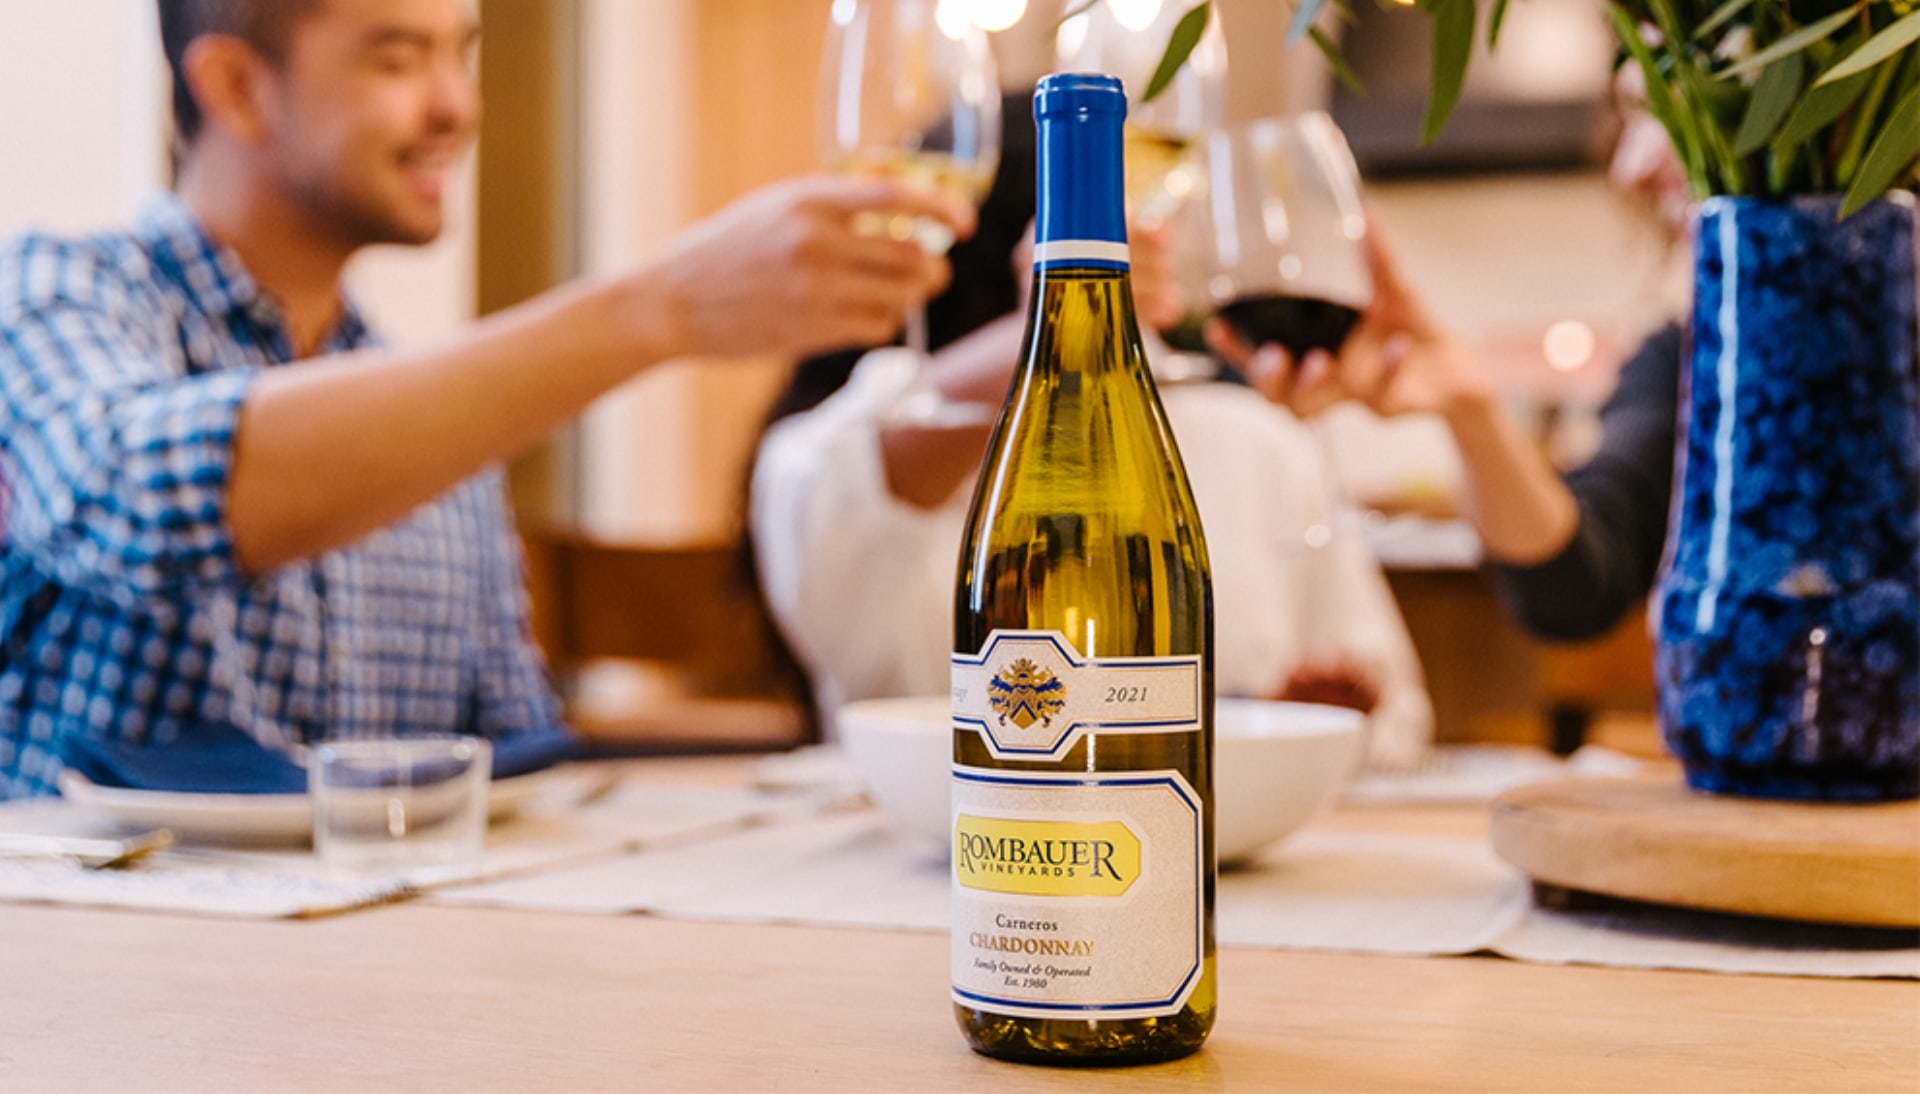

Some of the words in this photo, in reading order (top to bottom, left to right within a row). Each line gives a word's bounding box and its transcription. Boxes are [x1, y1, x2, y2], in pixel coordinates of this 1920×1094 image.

[1105, 686, 1149, 703] 2021
[960, 832, 1122, 881] ROMBAUER
[981, 862, 1075, 877] VINEYARDS
[995, 913, 1058, 931] Carneros
[969, 932, 1094, 956] CHARDONNAY
[973, 958, 997, 973] Family
[999, 962, 1030, 975] Owned
[1031, 965, 1042, 975] &
[1044, 965, 1092, 978] Operated
